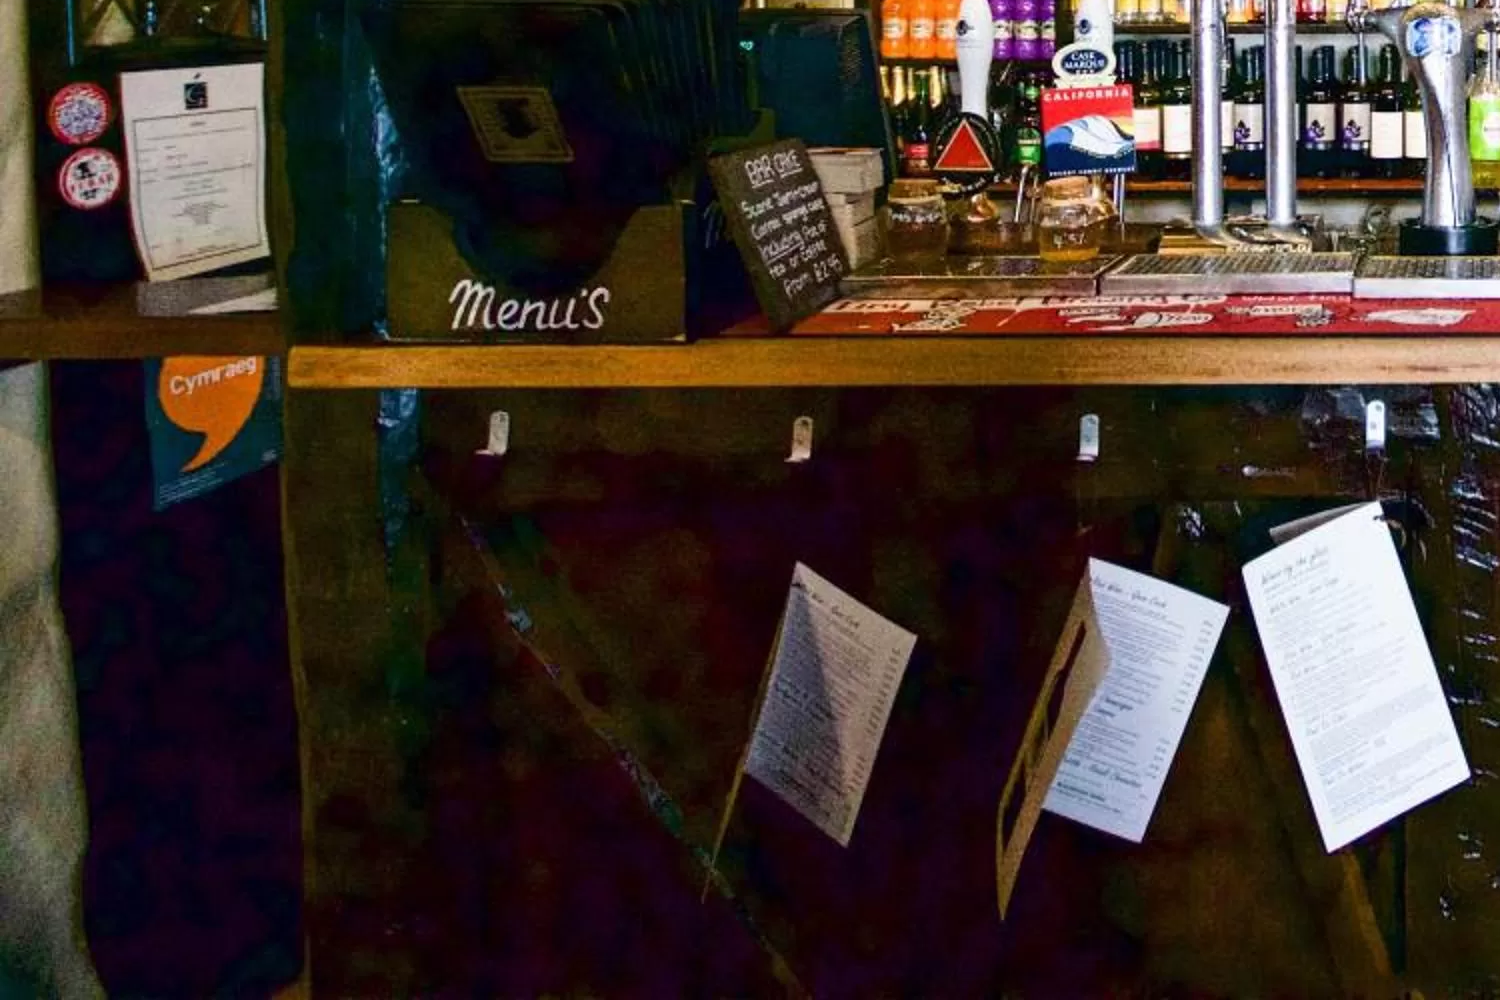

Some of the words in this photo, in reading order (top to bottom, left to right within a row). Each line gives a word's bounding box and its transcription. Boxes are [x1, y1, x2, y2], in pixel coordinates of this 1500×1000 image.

[1070, 51, 1096, 61] CASK
[1043, 87, 1130, 102] CALIFORNIA
[745, 155, 775, 184] BAR
[169, 355, 257, 395] Cymraeg
